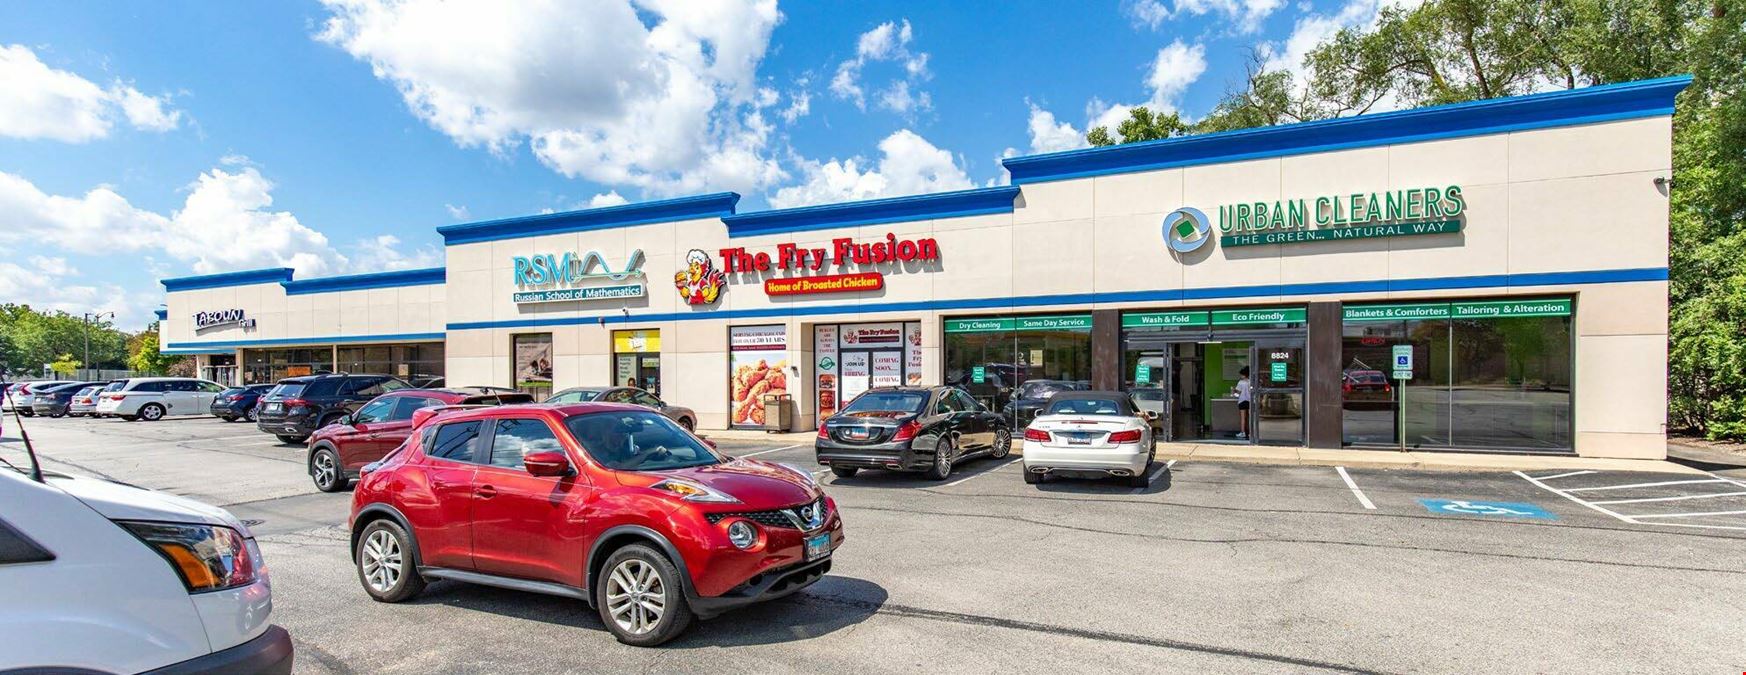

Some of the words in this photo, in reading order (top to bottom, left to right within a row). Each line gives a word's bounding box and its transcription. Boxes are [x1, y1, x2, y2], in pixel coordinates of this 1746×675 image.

[1218, 198, 1306, 233] URBAN
[1315, 185, 1464, 226] CLEANERS
[1233, 235, 1259, 245] THE
[1333, 225, 1405, 238] NATURAL
[1413, 222, 1446, 233] WAY
[719, 247, 770, 274] The
[777, 243, 826, 270] Fry
[832, 232, 939, 266] Fusion
[513, 252, 571, 287] RSM
[768, 282, 791, 293] Home
[793, 281, 801, 291] of
[803, 280, 842, 291] Broasted
[843, 277, 878, 288] Chicken
[515, 293, 543, 302] Russian
[546, 291, 572, 301] School
[574, 289, 583, 299] of
[586, 286, 640, 298] Mathematics
[1346, 309, 1385, 318] Blankets
[1386, 309, 1393, 317] &
[1394, 307, 1448, 317] Comforters
[1457, 305, 1499, 315] Tailoring
[1503, 305, 1512, 314] &
[1513, 303, 1565, 313] Alteration
[1024, 320, 1043, 328] Same
[1044, 319, 1057, 328] Day
[1059, 318, 1085, 327] Service
[1141, 316, 1163, 324] Wash
[1172, 315, 1190, 323] Fold
[1232, 313, 1248, 321] Eco
[1249, 312, 1285, 322] Friendly
[959, 323, 971, 331] Dry
[972, 322, 1001, 330] Cleaning
[1271, 352, 1289, 360] 8824
